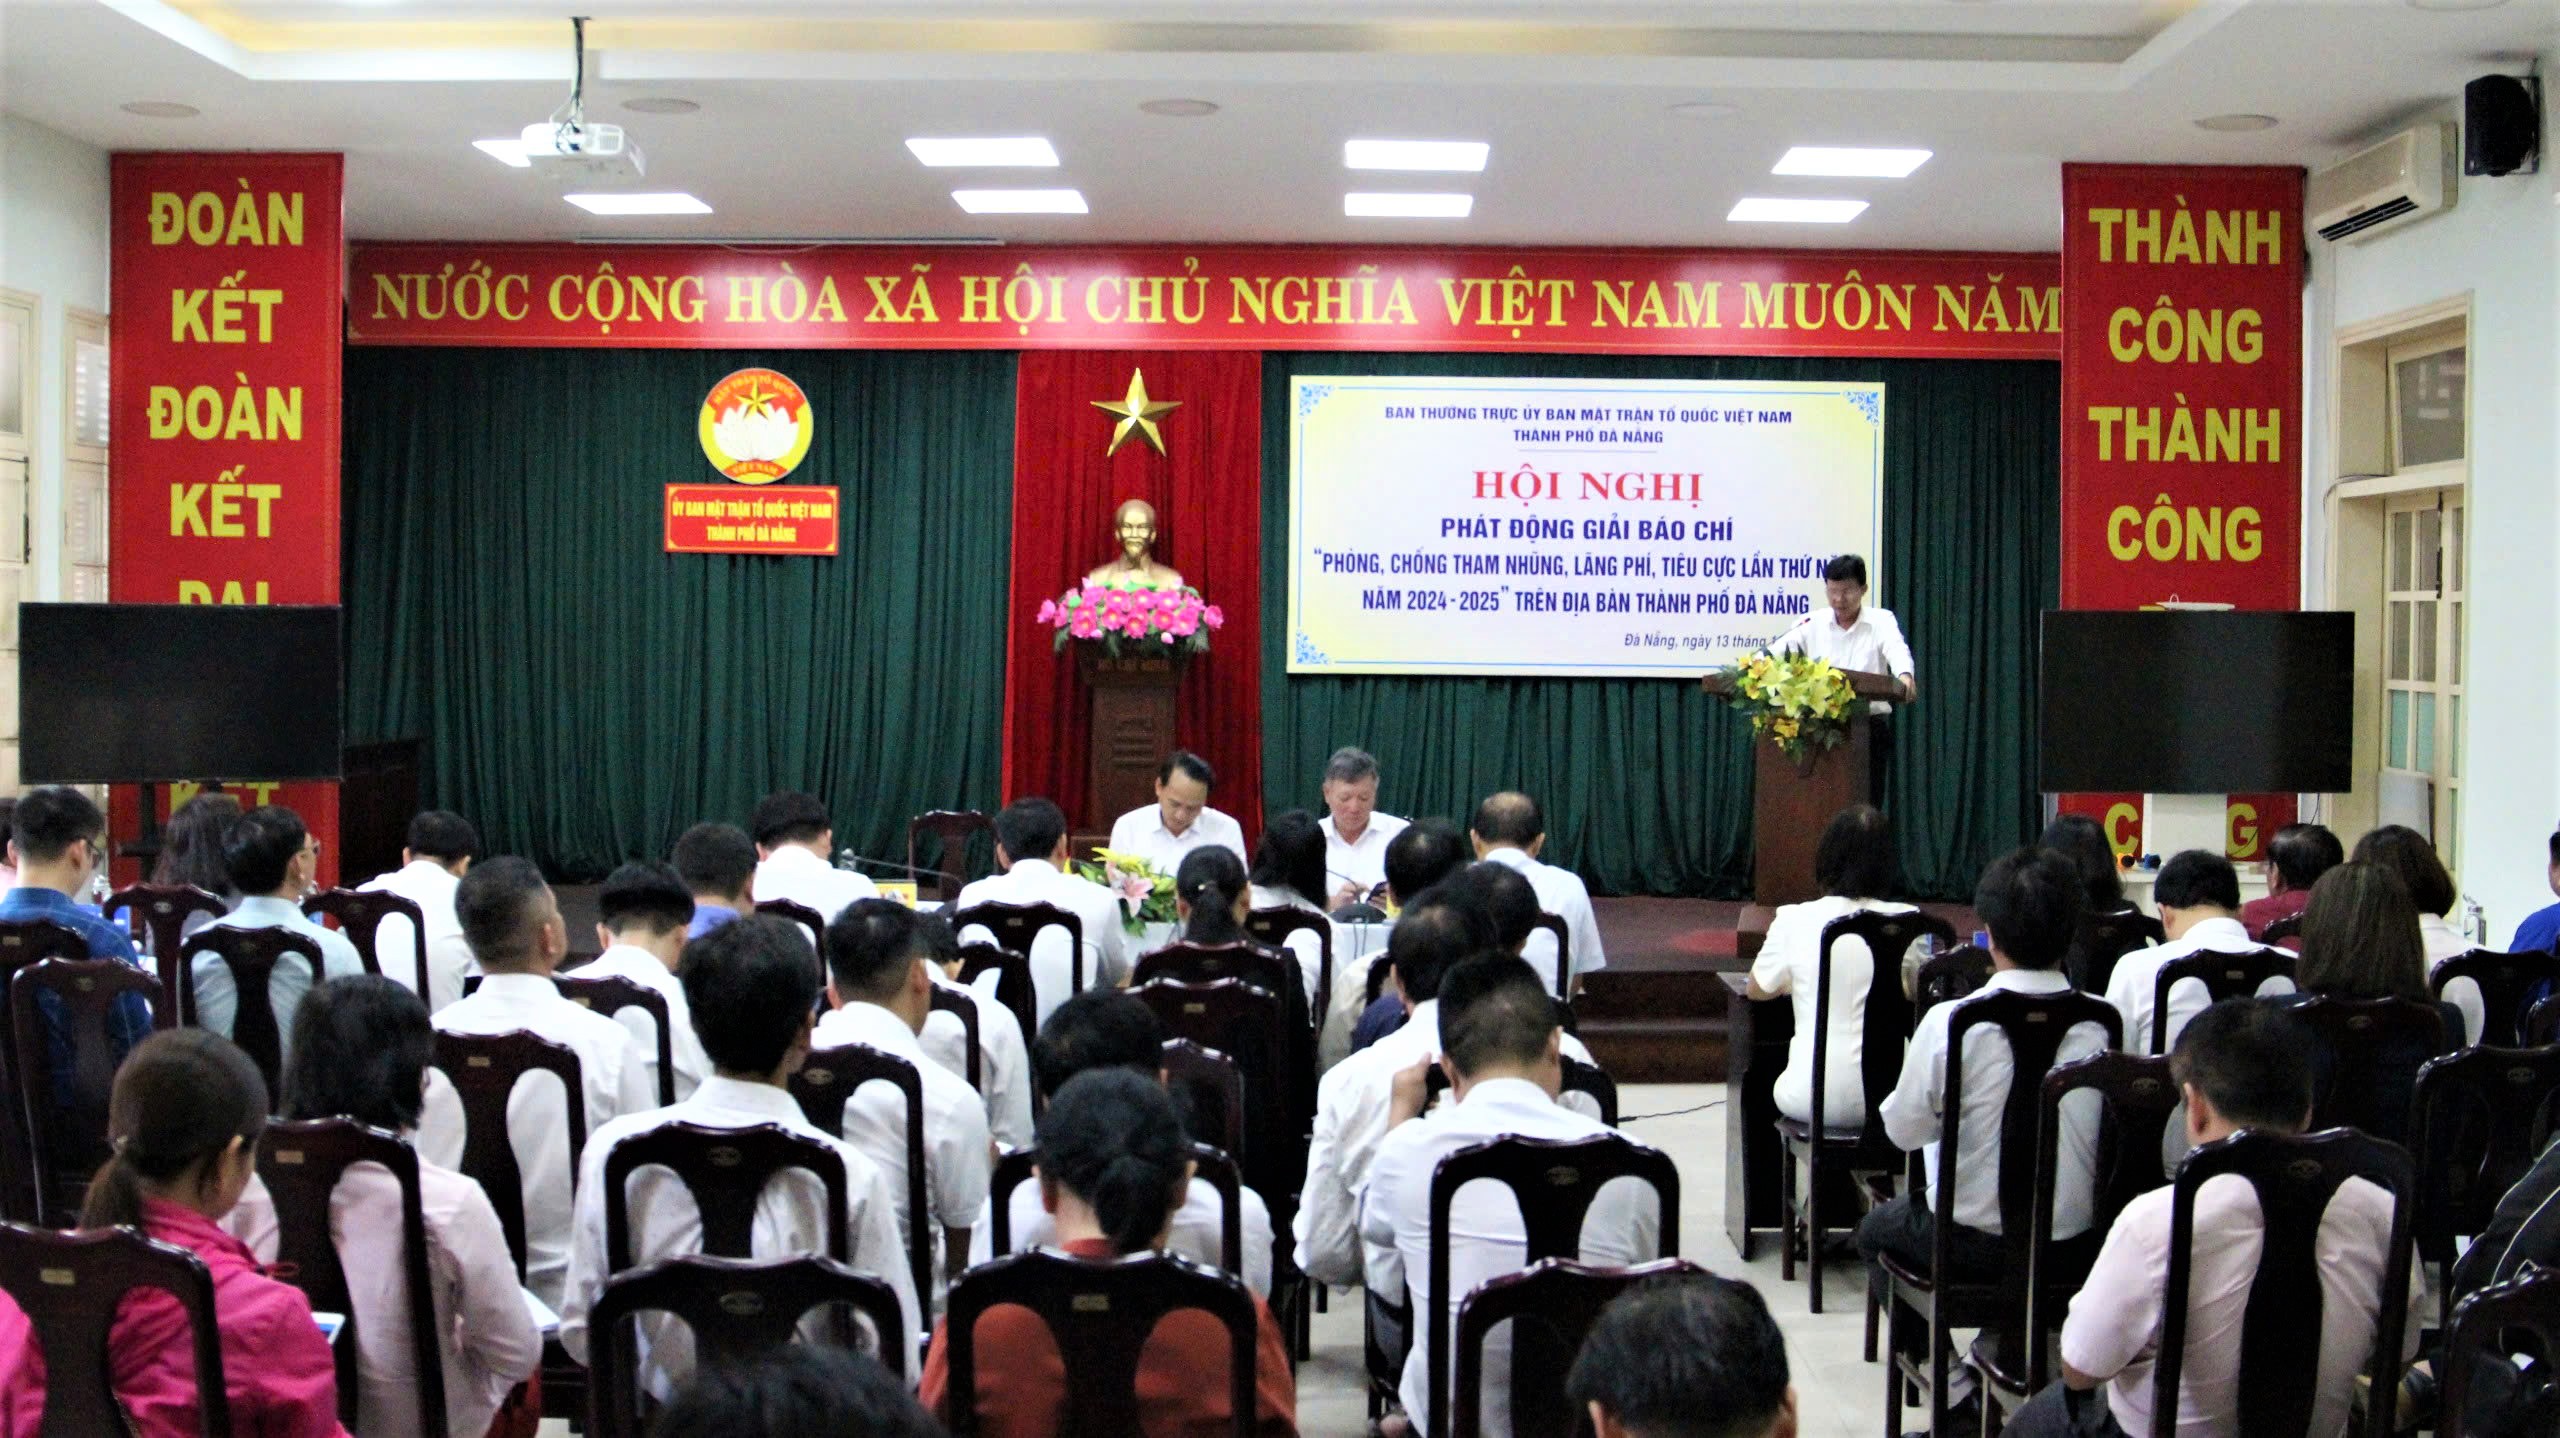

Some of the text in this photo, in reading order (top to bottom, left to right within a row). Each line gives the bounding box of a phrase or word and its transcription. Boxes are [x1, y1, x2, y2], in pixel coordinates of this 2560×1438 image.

[149, 178, 303, 245] ĐOÀN
[2089, 196, 2280, 264] THÀNH
[172, 270, 283, 342] KẾT
[373, 256, 2063, 339] NƯỚC CỘNG HÒA XÃ HỘI CHỦ NGHĨA VIỆT NAM MUÔN NĂM
[2109, 296, 2262, 363] CÔNG
[147, 373, 302, 440] ĐOÀN
[1385, 407, 1415, 419] BAN
[1546, 408, 1576, 421] BAN
[1724, 408, 1753, 425] VIỆT
[1758, 411, 1792, 423] NAM
[2088, 393, 2280, 462] THÀNH
[171, 465, 281, 537] KẾT
[1472, 463, 1703, 509] HỘI NGHỊ
[1441, 512, 1733, 544] PHÁT ĐỘNG GIẢI BÁO CHÍ
[2108, 493, 2261, 561] CÔNG
[1453, 554, 1500, 575] THAM
[1661, 552, 1697, 578] TIÊU
[1703, 555, 1736, 582] CỰC
[1779, 554, 1812, 579] THỨ
[1363, 586, 1401, 610] NĂM
[1514, 587, 1557, 612] TRÊN
[1562, 592, 1590, 616] ĐỊA
[1596, 588, 1630, 613] BÀN
[1636, 589, 1691, 614] THÀNH
[1696, 586, 1730, 614] PHỐ
[1735, 589, 1757, 614] ĐÀ
[1625, 633, 1640, 646] Đà
[1682, 634, 1712, 651] ngày
[1717, 635, 1729, 647] 13
